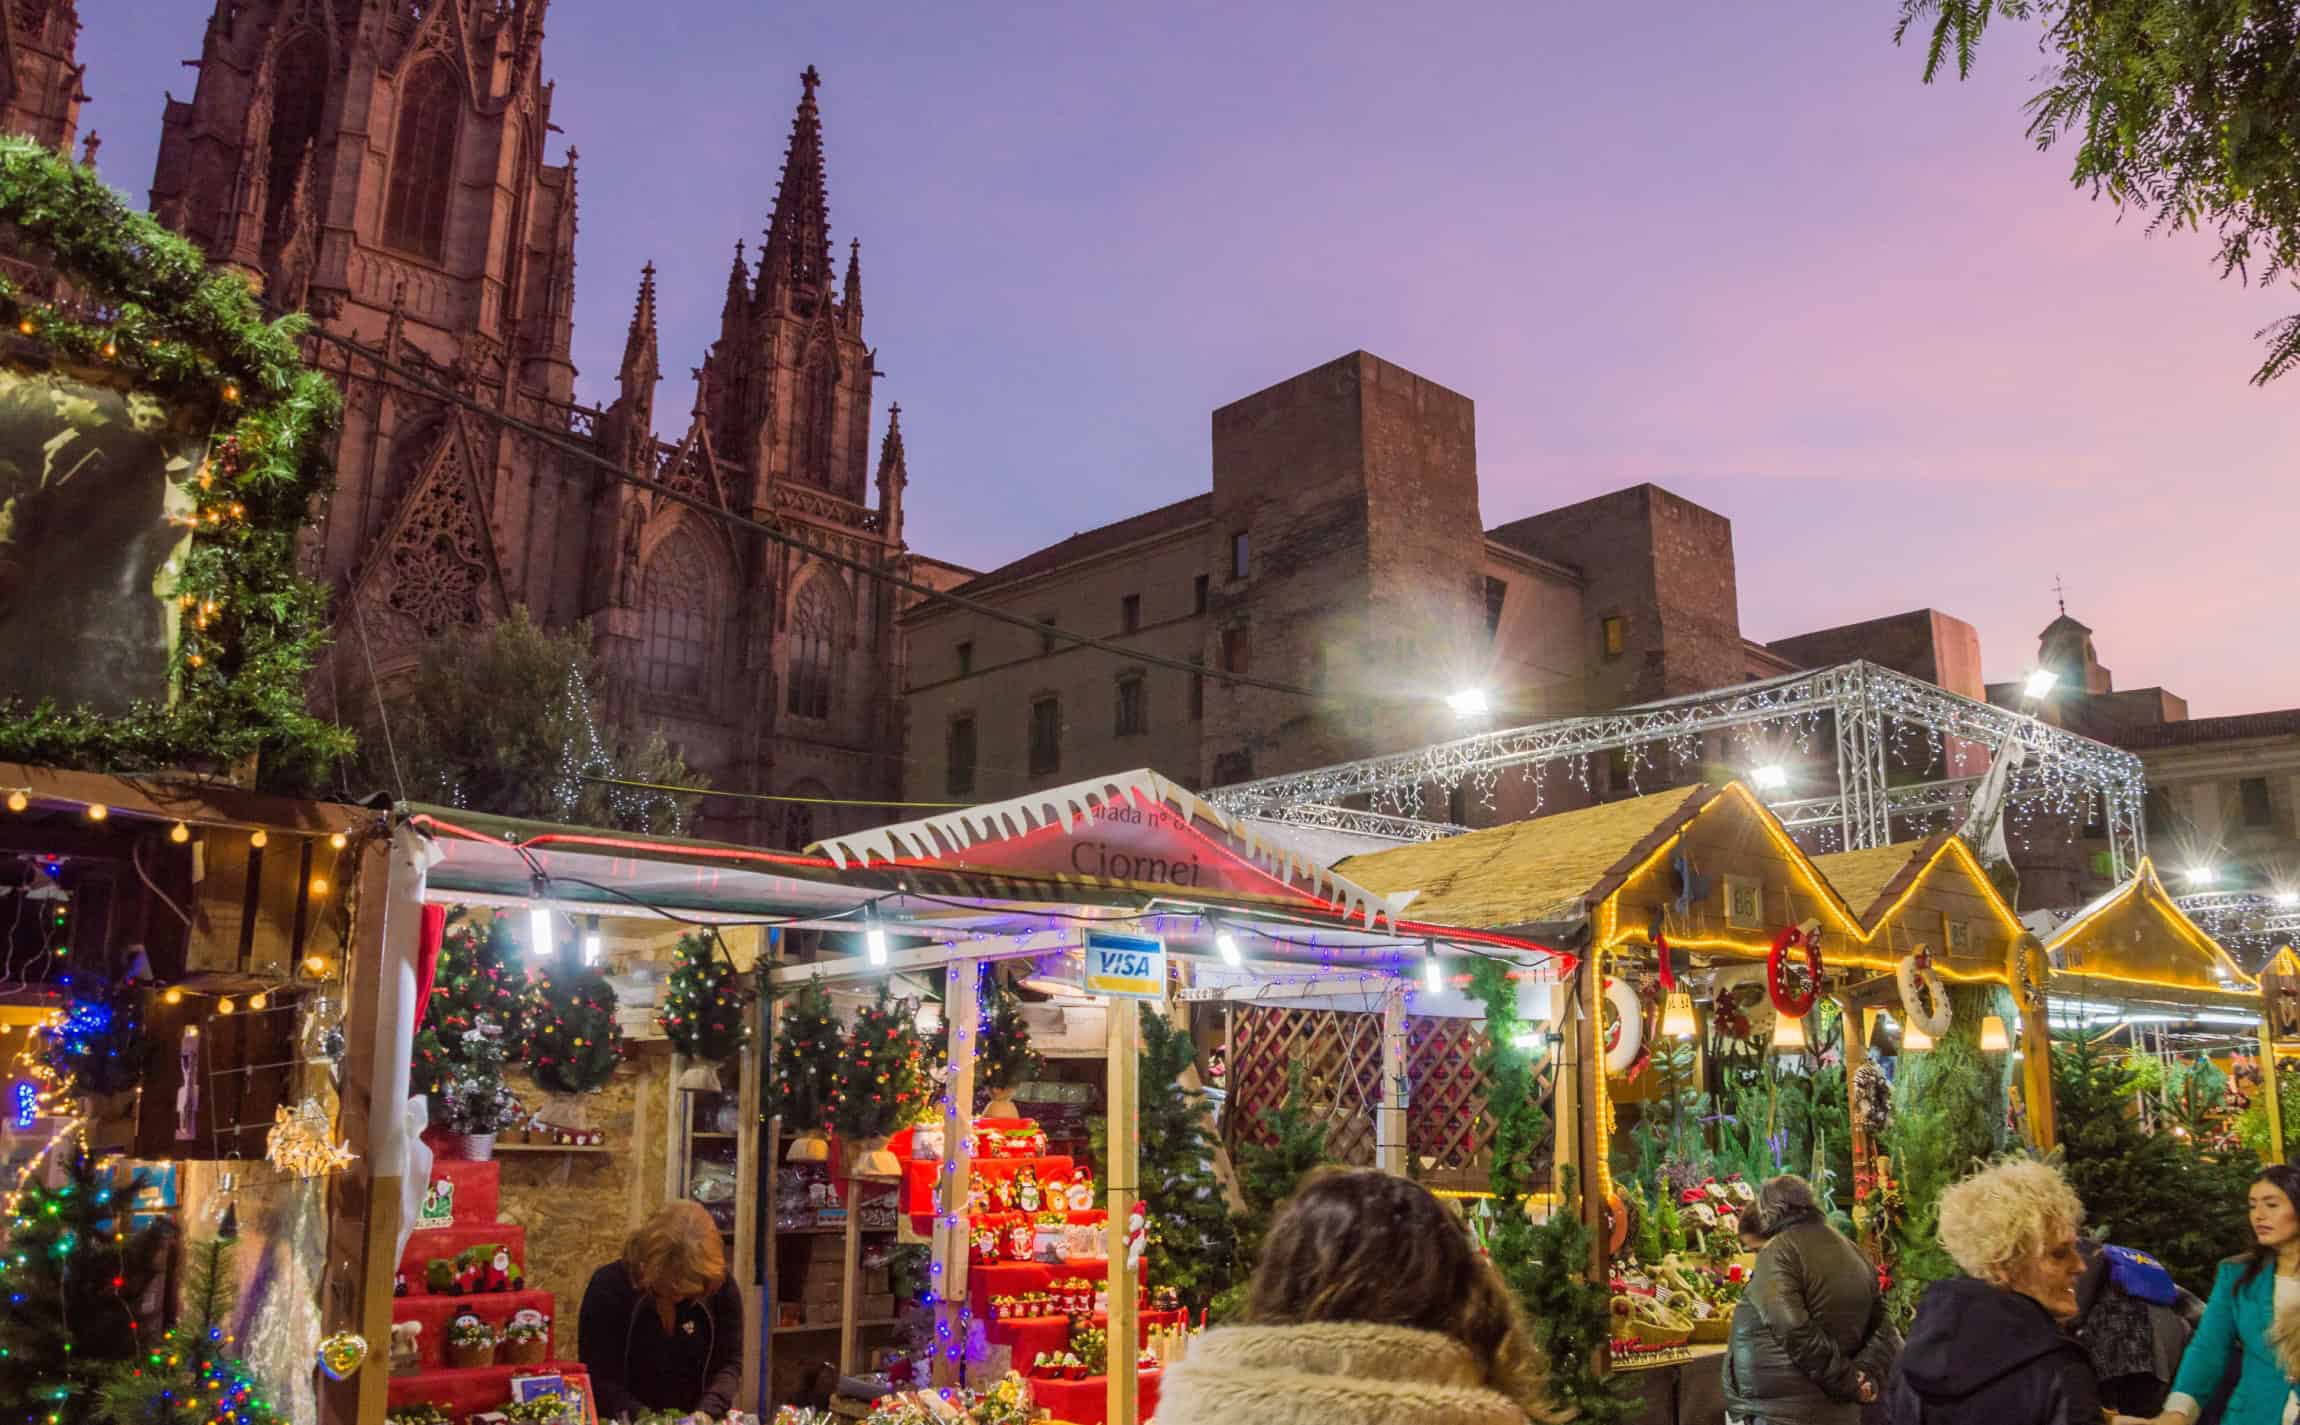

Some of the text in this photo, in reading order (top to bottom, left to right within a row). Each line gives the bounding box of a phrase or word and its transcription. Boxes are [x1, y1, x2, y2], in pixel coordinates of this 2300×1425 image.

[1076, 804, 1142, 825] arada
[1071, 841, 1200, 888] Ciornei
[1100, 951, 1150, 977] VISA
